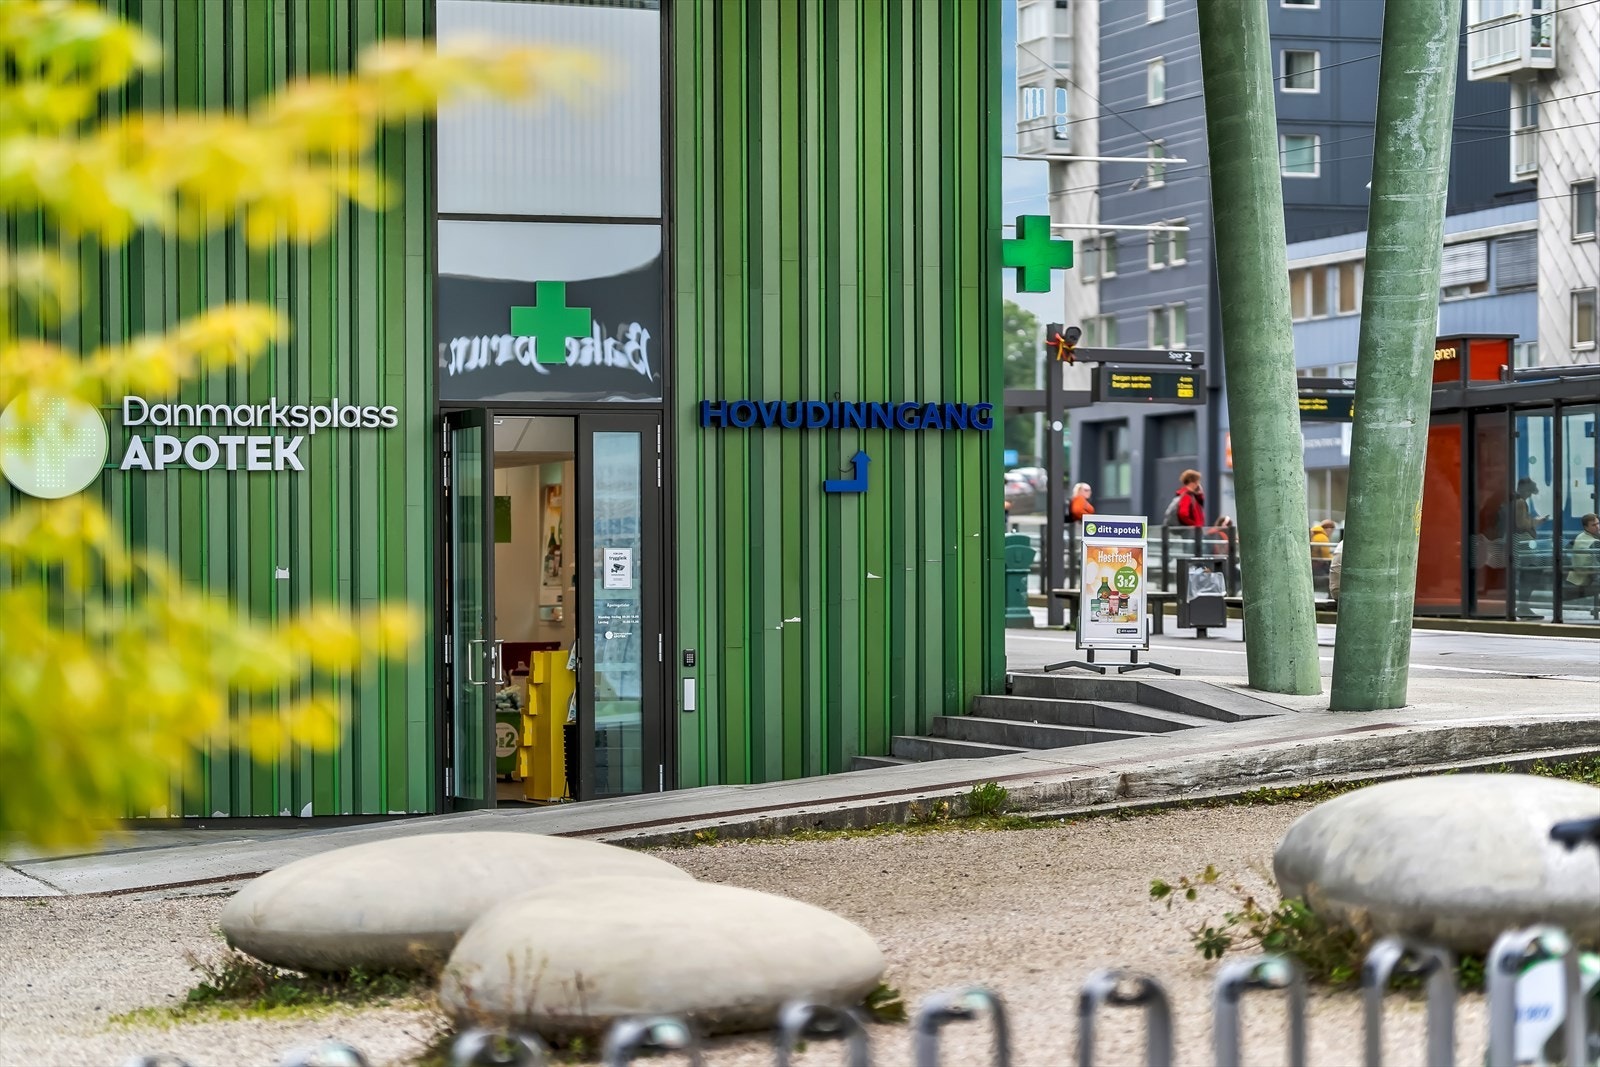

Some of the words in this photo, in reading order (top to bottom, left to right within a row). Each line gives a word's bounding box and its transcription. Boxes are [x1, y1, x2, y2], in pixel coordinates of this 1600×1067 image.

[1184, 352, 1192, 362] 2
[1434, 347, 1456, 361] anen
[123, 395, 399, 434] Danmarksplass
[700, 399, 994, 431] HOVUDINNGANG
[120, 434, 305, 471] APOTEK
[1097, 525, 1112, 534] ditt
[1113, 526, 1141, 535] apotek
[1117, 575, 1124, 588] 3
[1129, 575, 1136, 588] 2
[505, 731, 515, 748] 2
